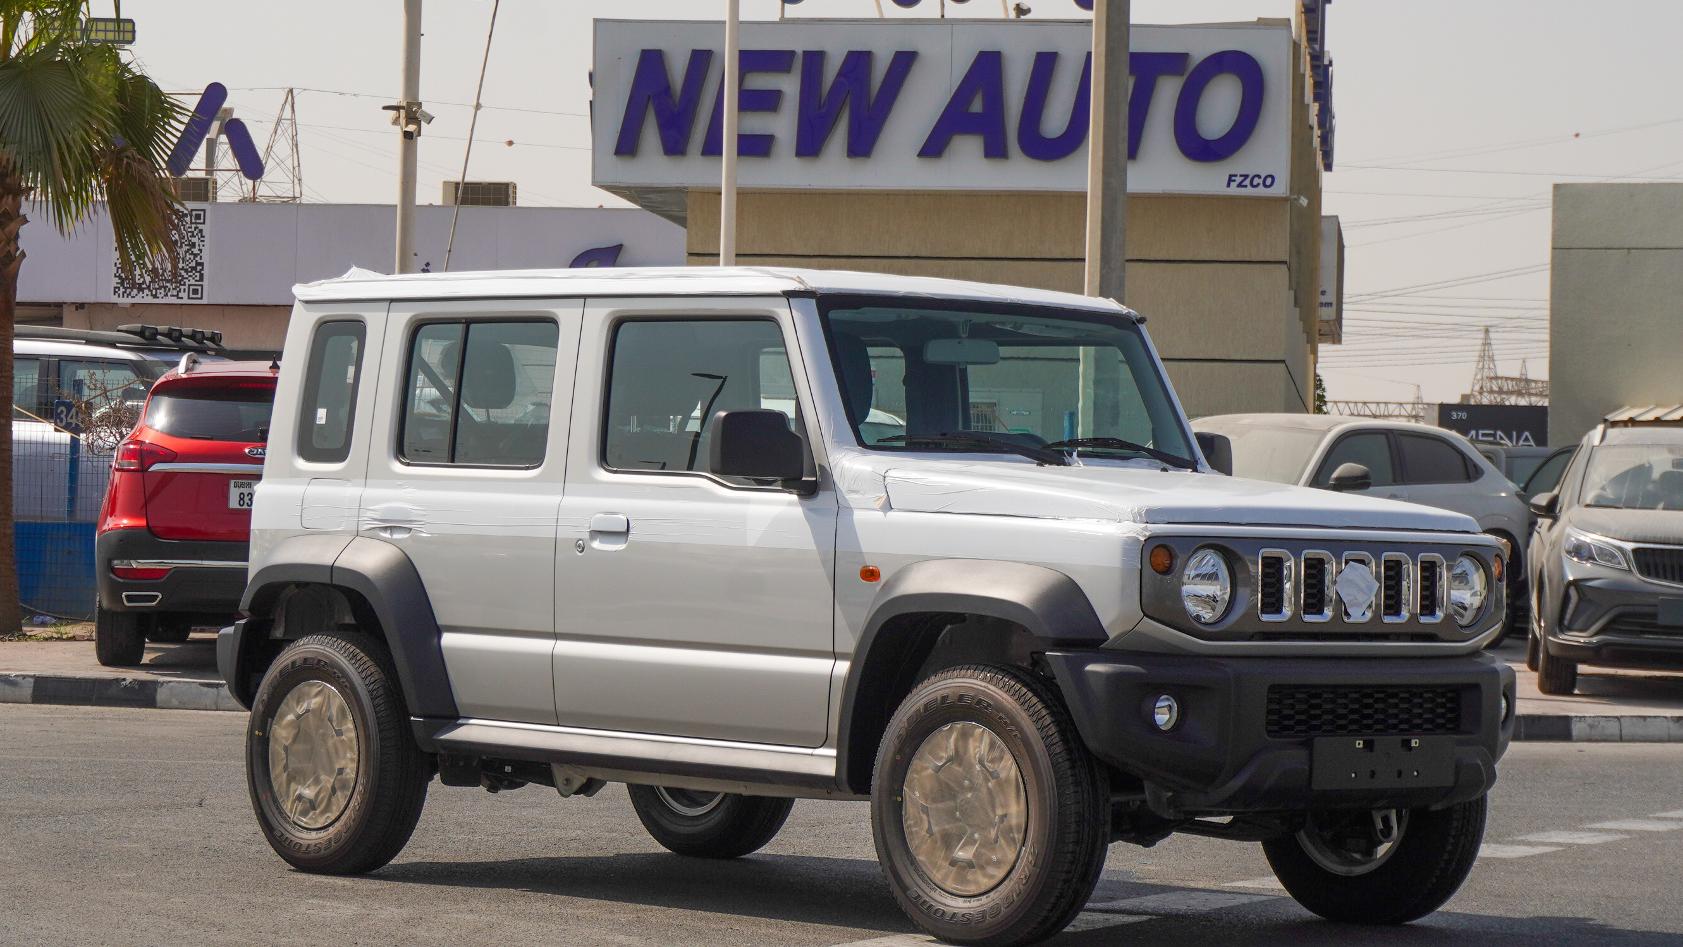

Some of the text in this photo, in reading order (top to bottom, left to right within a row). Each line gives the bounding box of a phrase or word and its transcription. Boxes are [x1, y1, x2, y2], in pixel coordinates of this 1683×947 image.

[614, 48, 919, 158] NEW
[916, 49, 1265, 163] AUTO
[1226, 174, 1276, 189] FZCO
[1451, 411, 1467, 420] 370
[238, 492, 253, 507] 83
